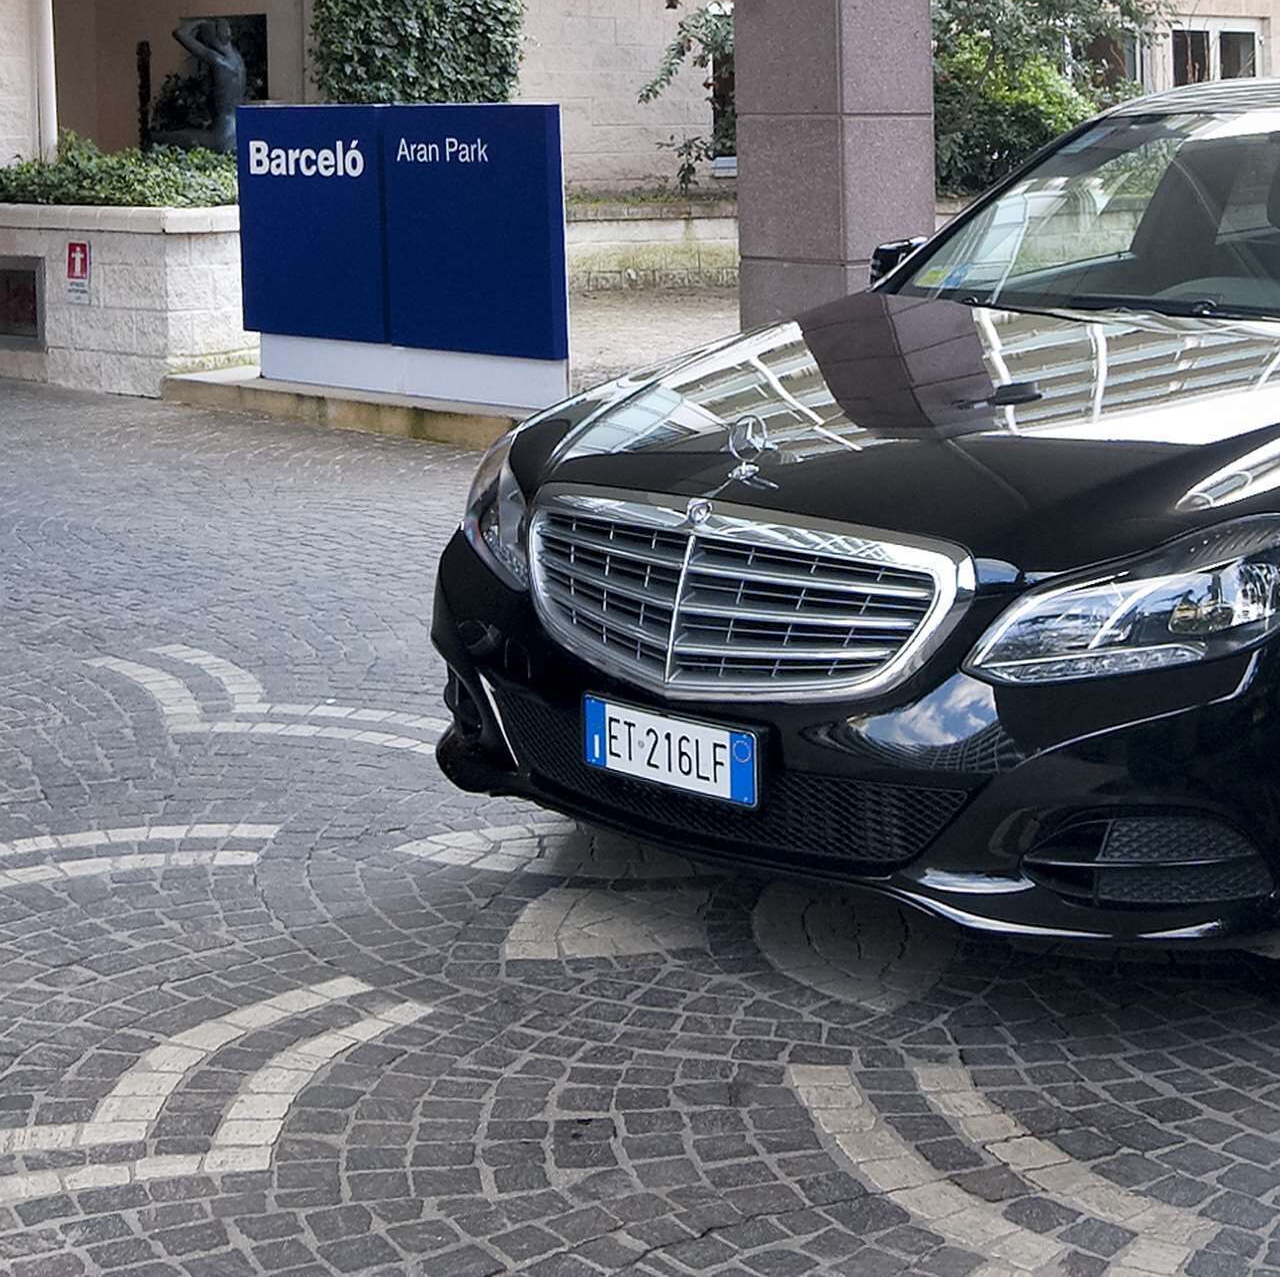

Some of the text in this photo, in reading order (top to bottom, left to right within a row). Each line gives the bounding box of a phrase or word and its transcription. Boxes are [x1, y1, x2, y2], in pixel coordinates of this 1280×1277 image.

[249, 140, 364, 177] Barceló
[396, 138, 489, 163] Aran Park
